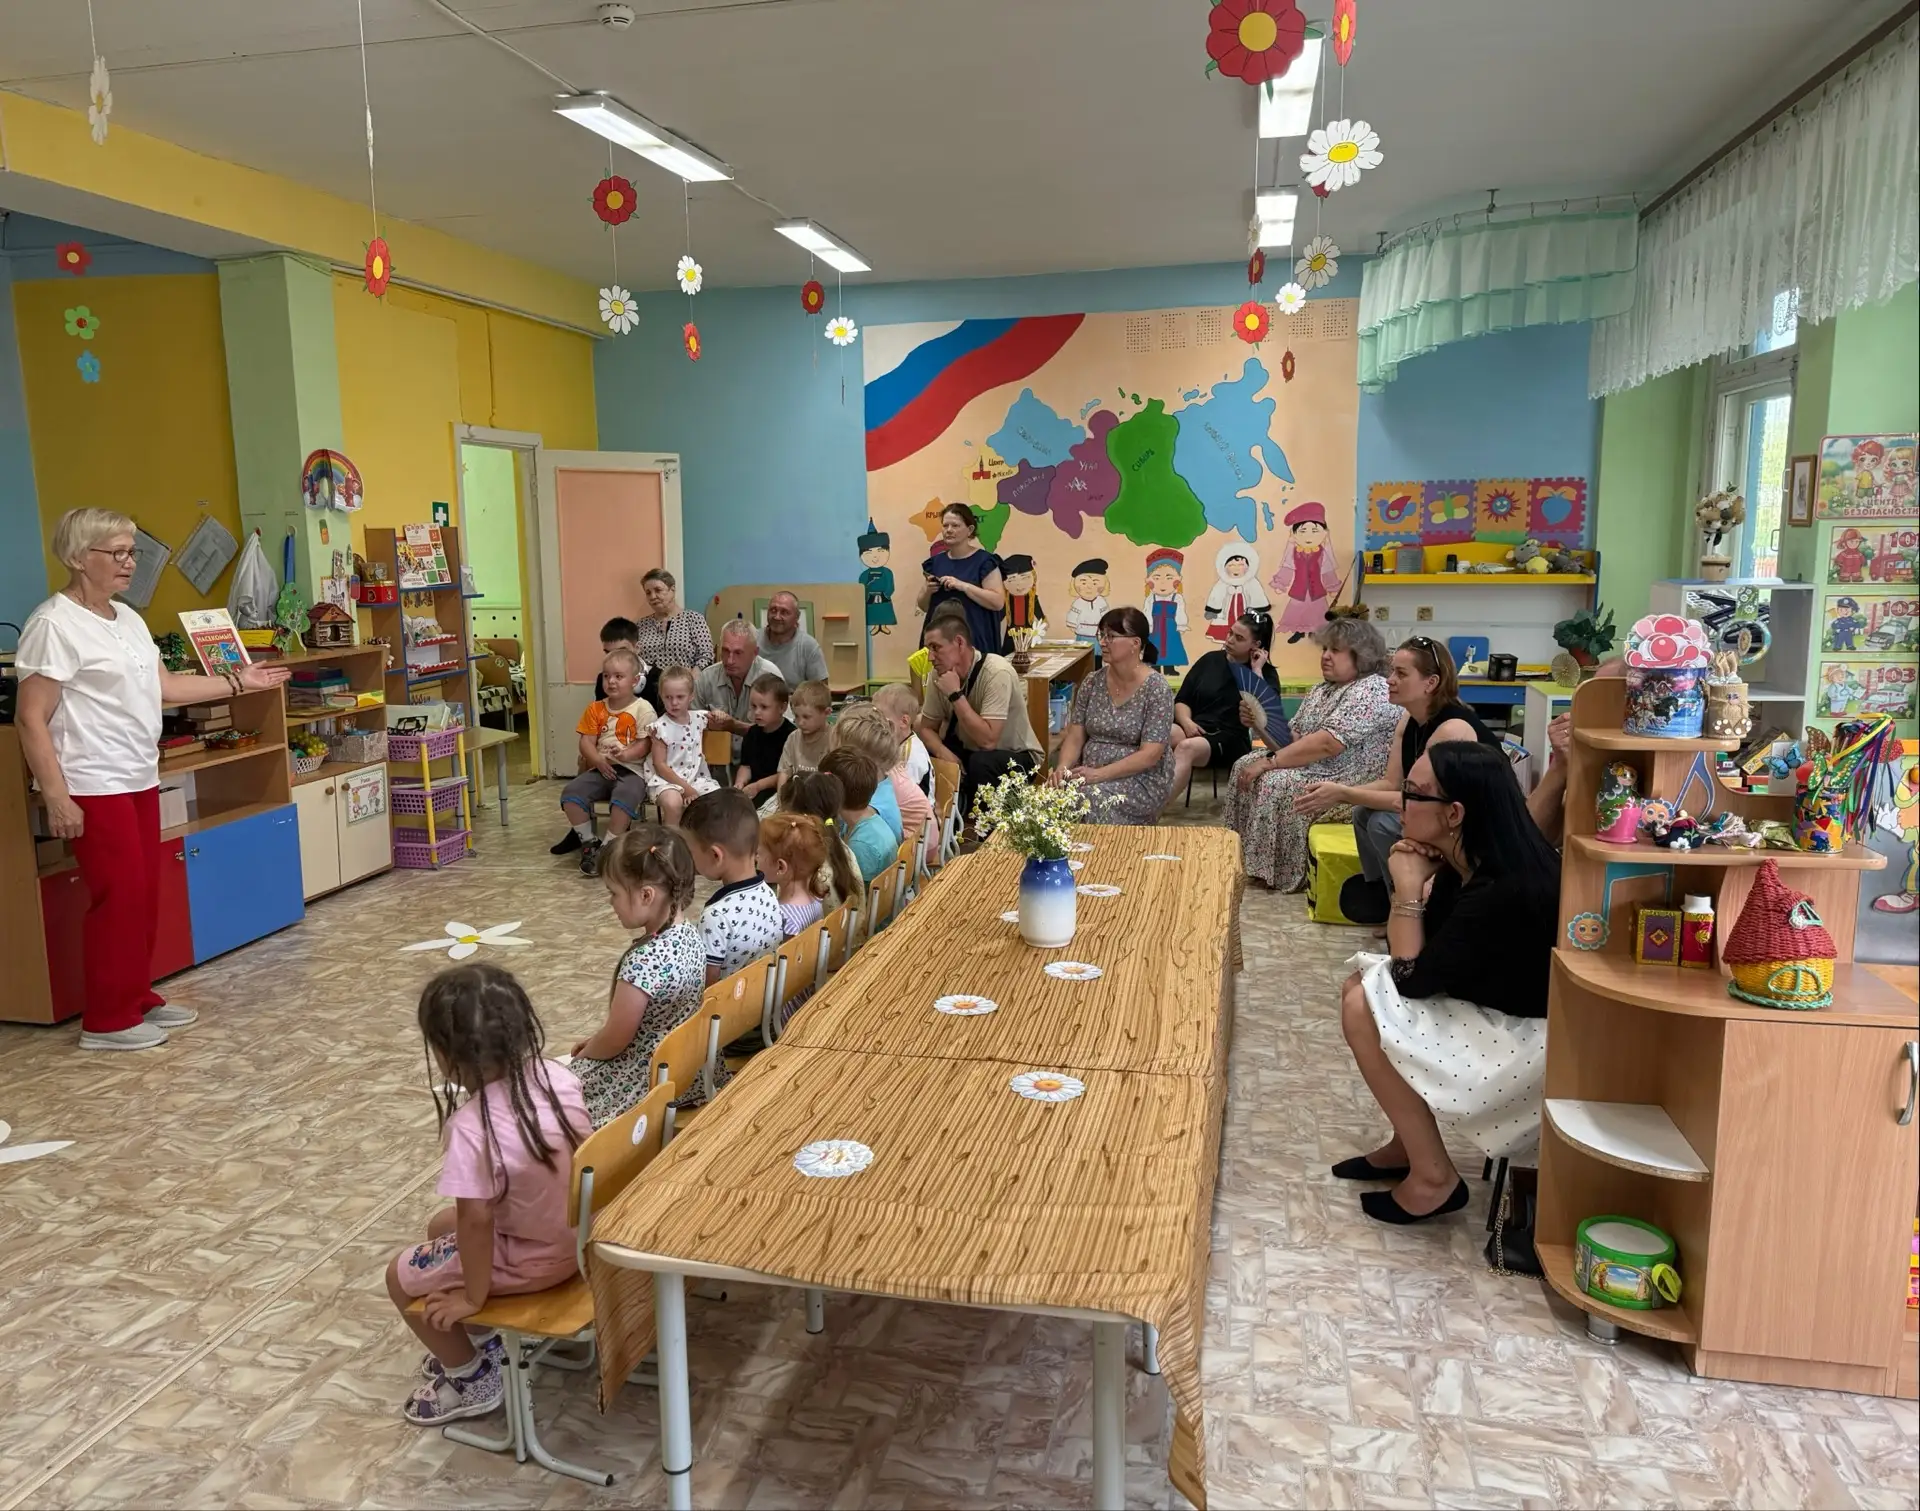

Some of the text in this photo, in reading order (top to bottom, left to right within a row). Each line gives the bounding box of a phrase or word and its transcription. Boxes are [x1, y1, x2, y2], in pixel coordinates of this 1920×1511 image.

[1867, 499, 1897, 508] ЦЕНТР
[1844, 508, 1918, 516] БЕЗОПАСНОСТИ
[1882, 600, 1919, 617] 102
[1876, 667, 1916, 684] 103
